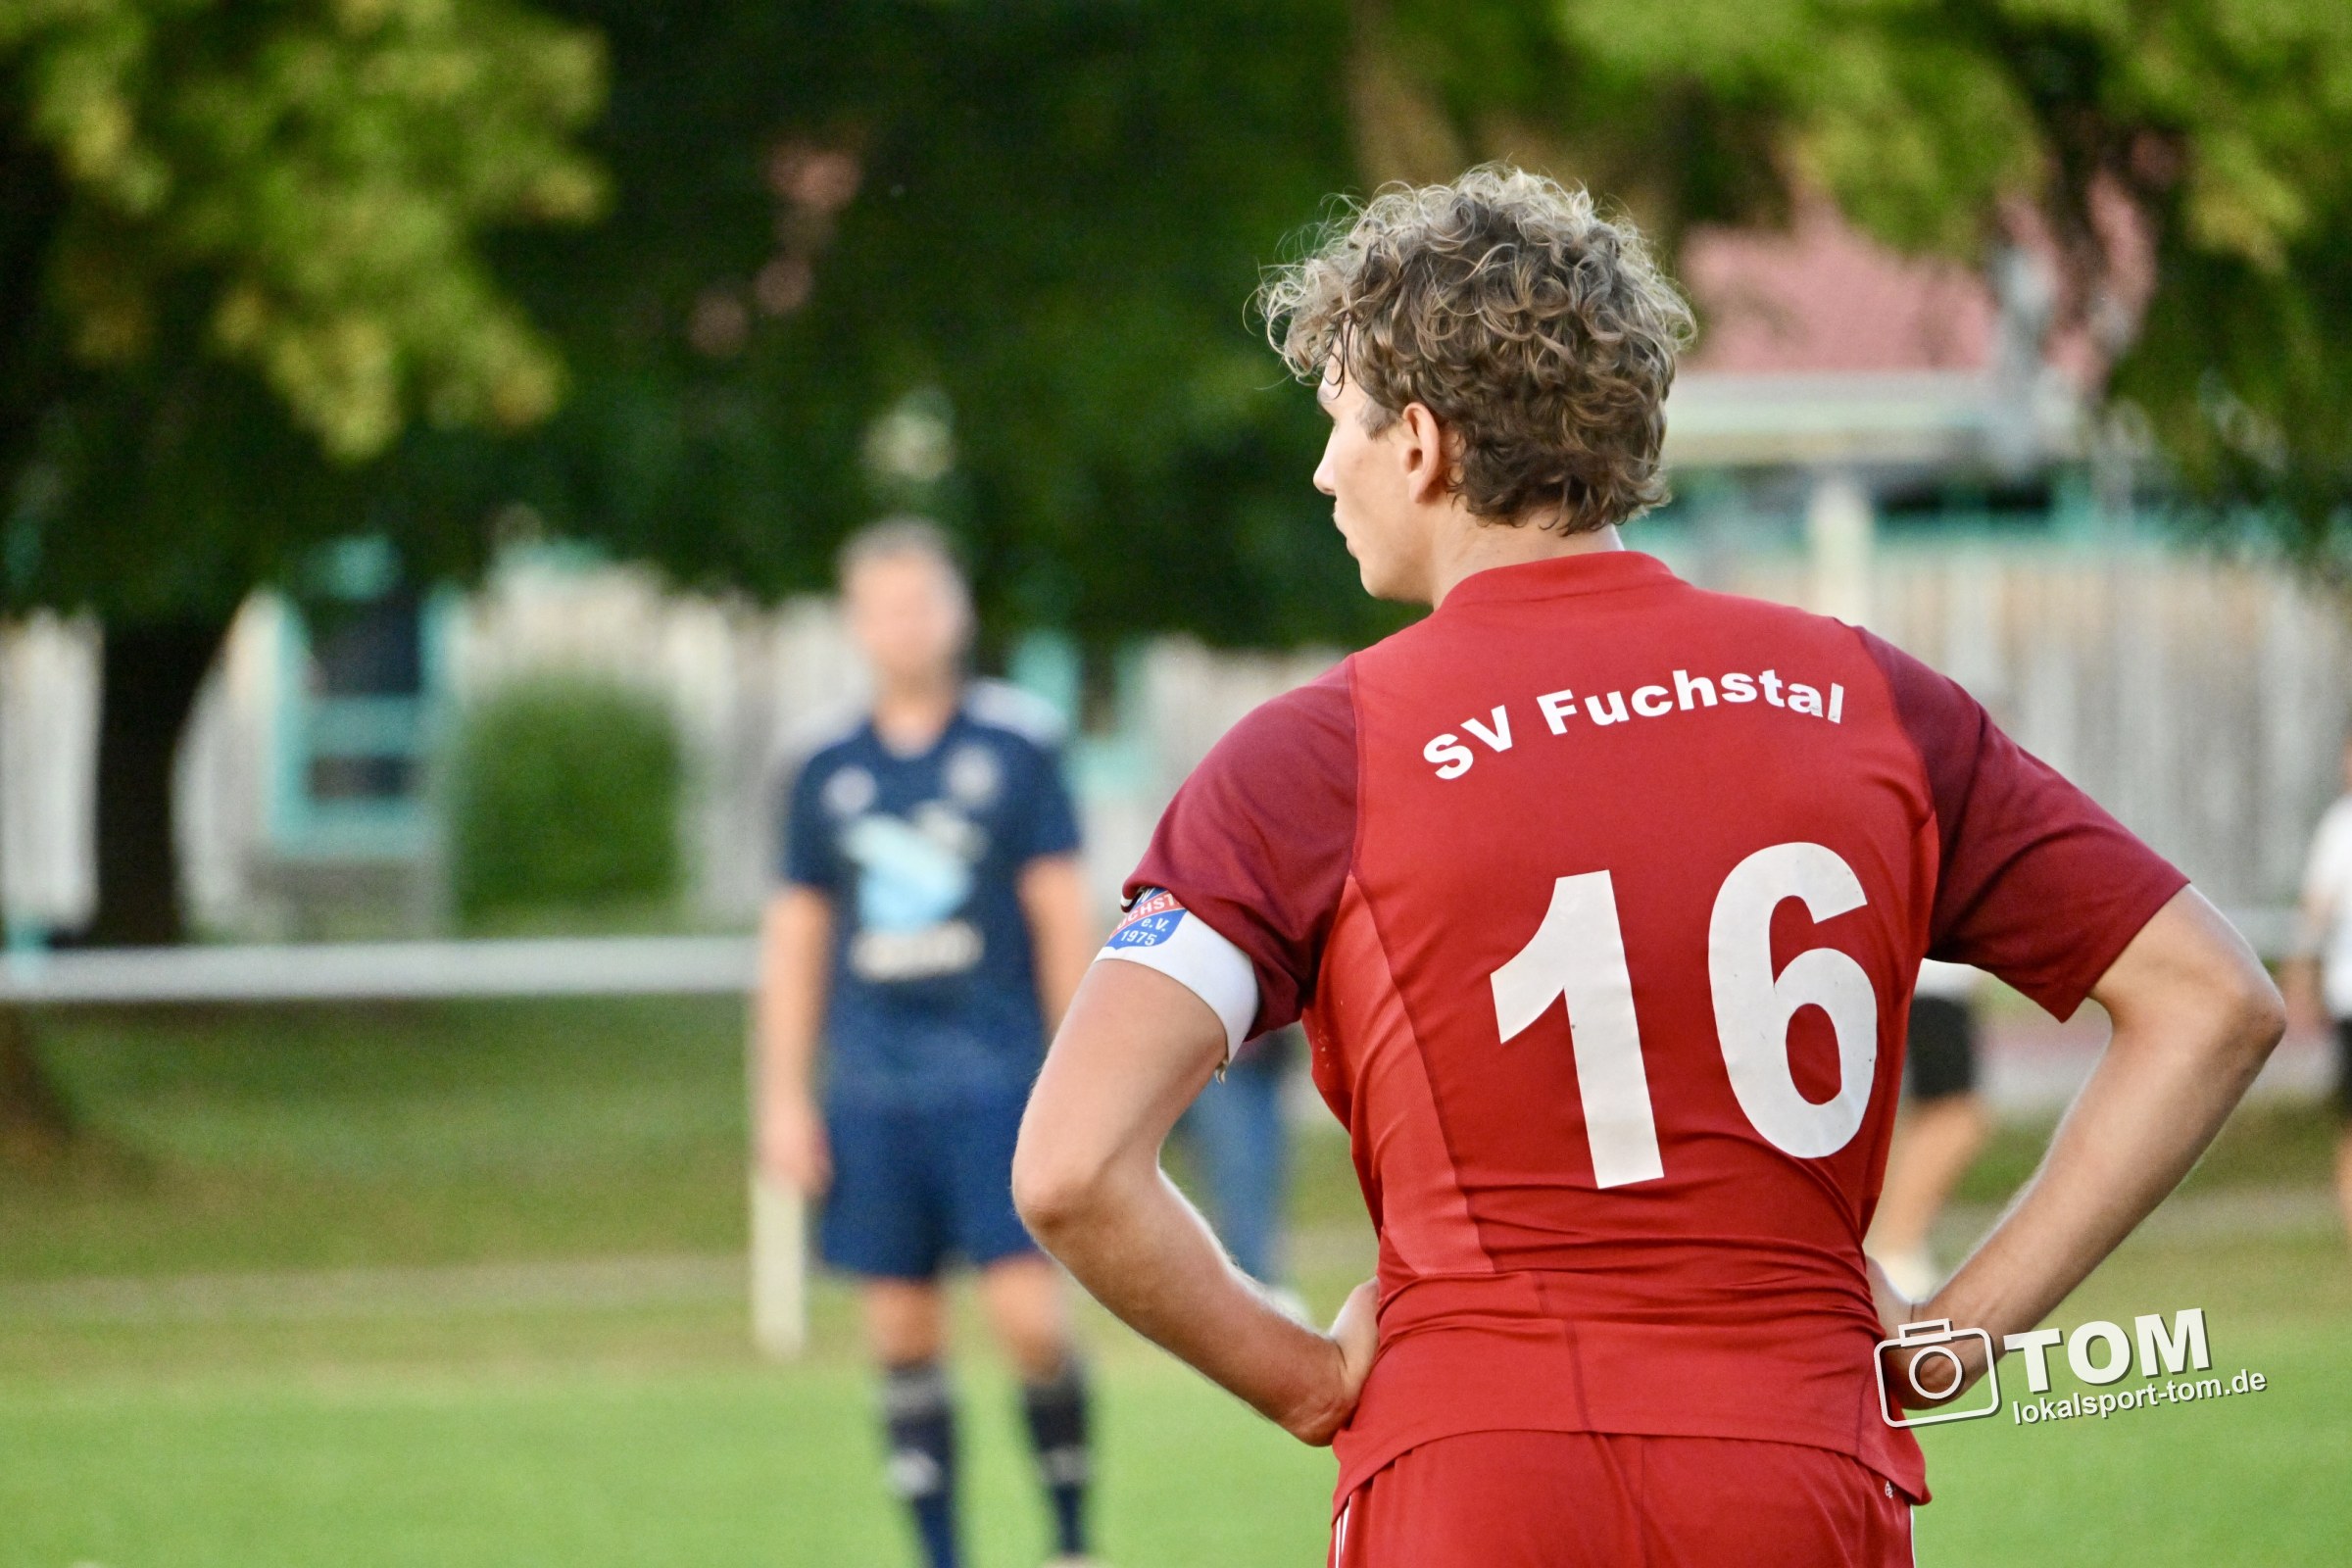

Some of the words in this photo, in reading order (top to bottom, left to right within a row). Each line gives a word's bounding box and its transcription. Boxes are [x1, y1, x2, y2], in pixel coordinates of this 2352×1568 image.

[1423, 705, 1513, 780] SV
[1537, 668, 1844, 736] Fuchstal
[1120, 929, 1157, 947] 1975
[1490, 843, 1878, 1189] 16
